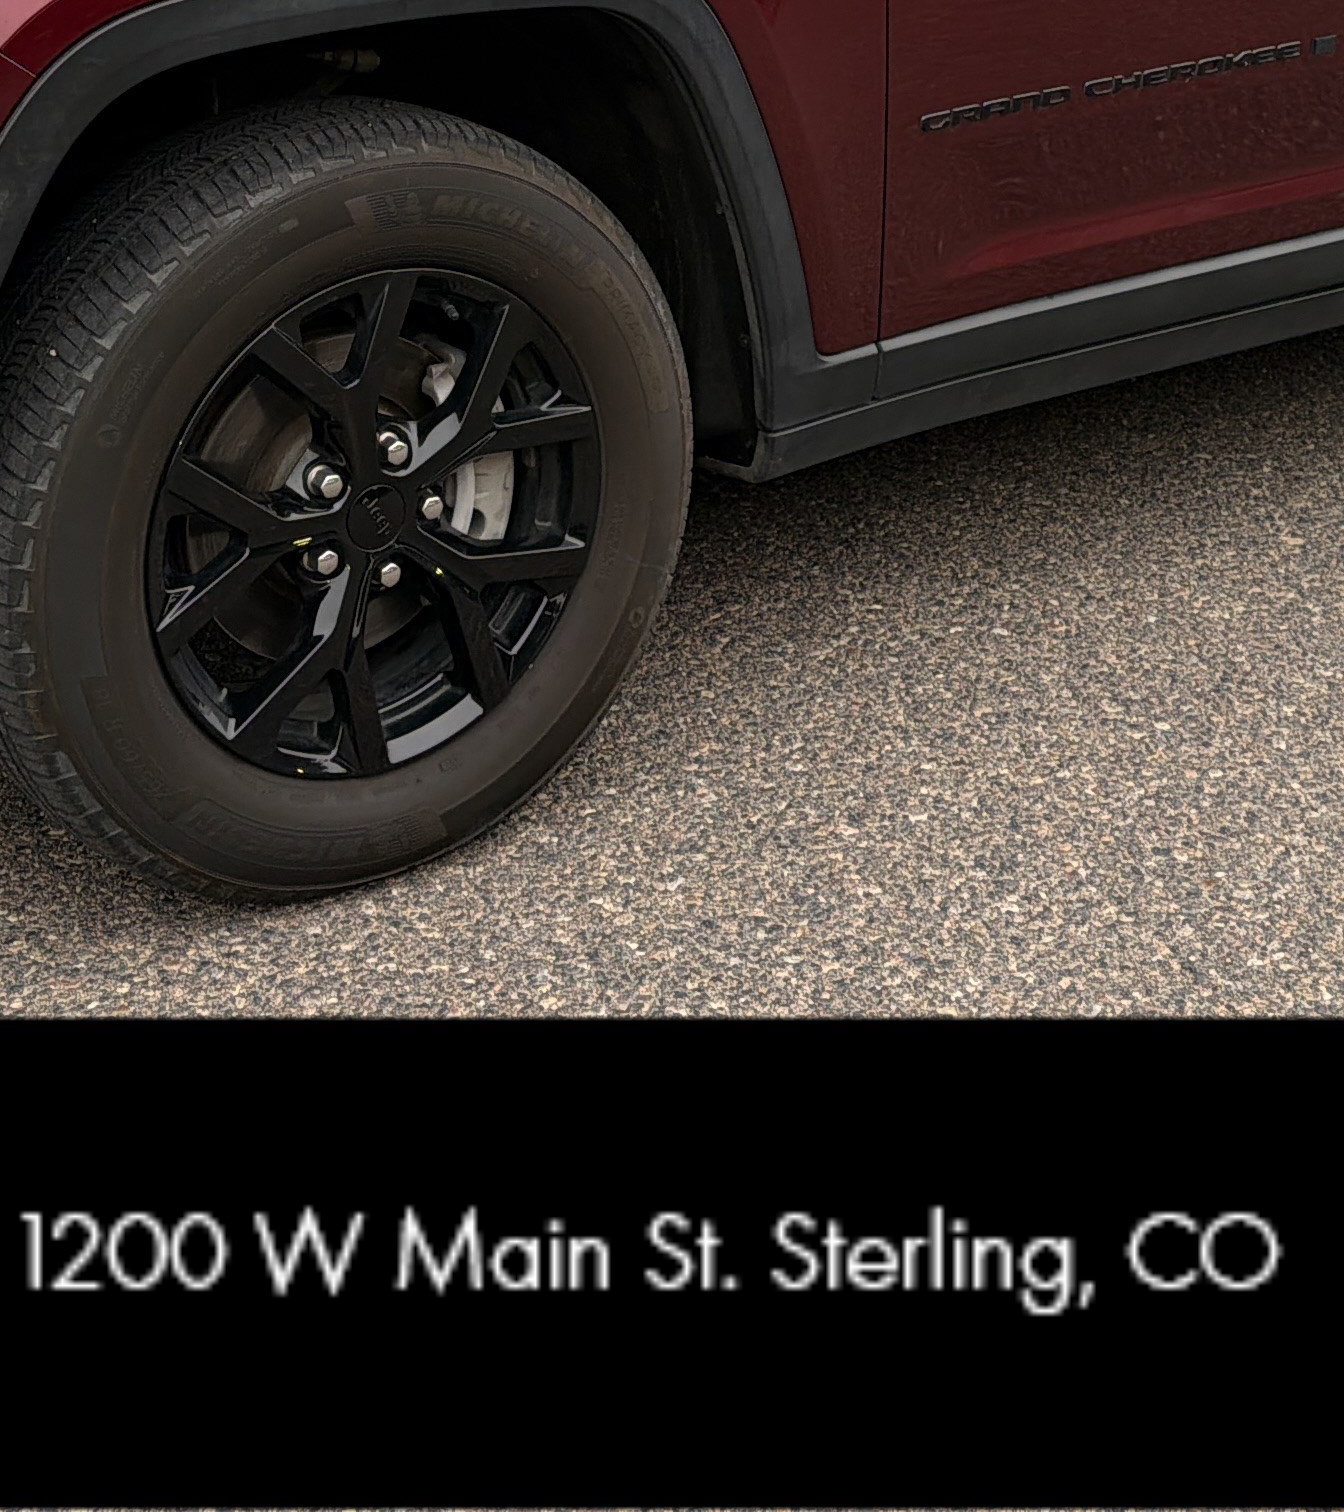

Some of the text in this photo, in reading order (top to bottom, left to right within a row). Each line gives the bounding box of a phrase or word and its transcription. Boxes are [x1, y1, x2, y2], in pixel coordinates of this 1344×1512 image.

[919, 40, 1302, 134] GRAND CHEROKEE
[361, 496, 391, 536] Jeep
